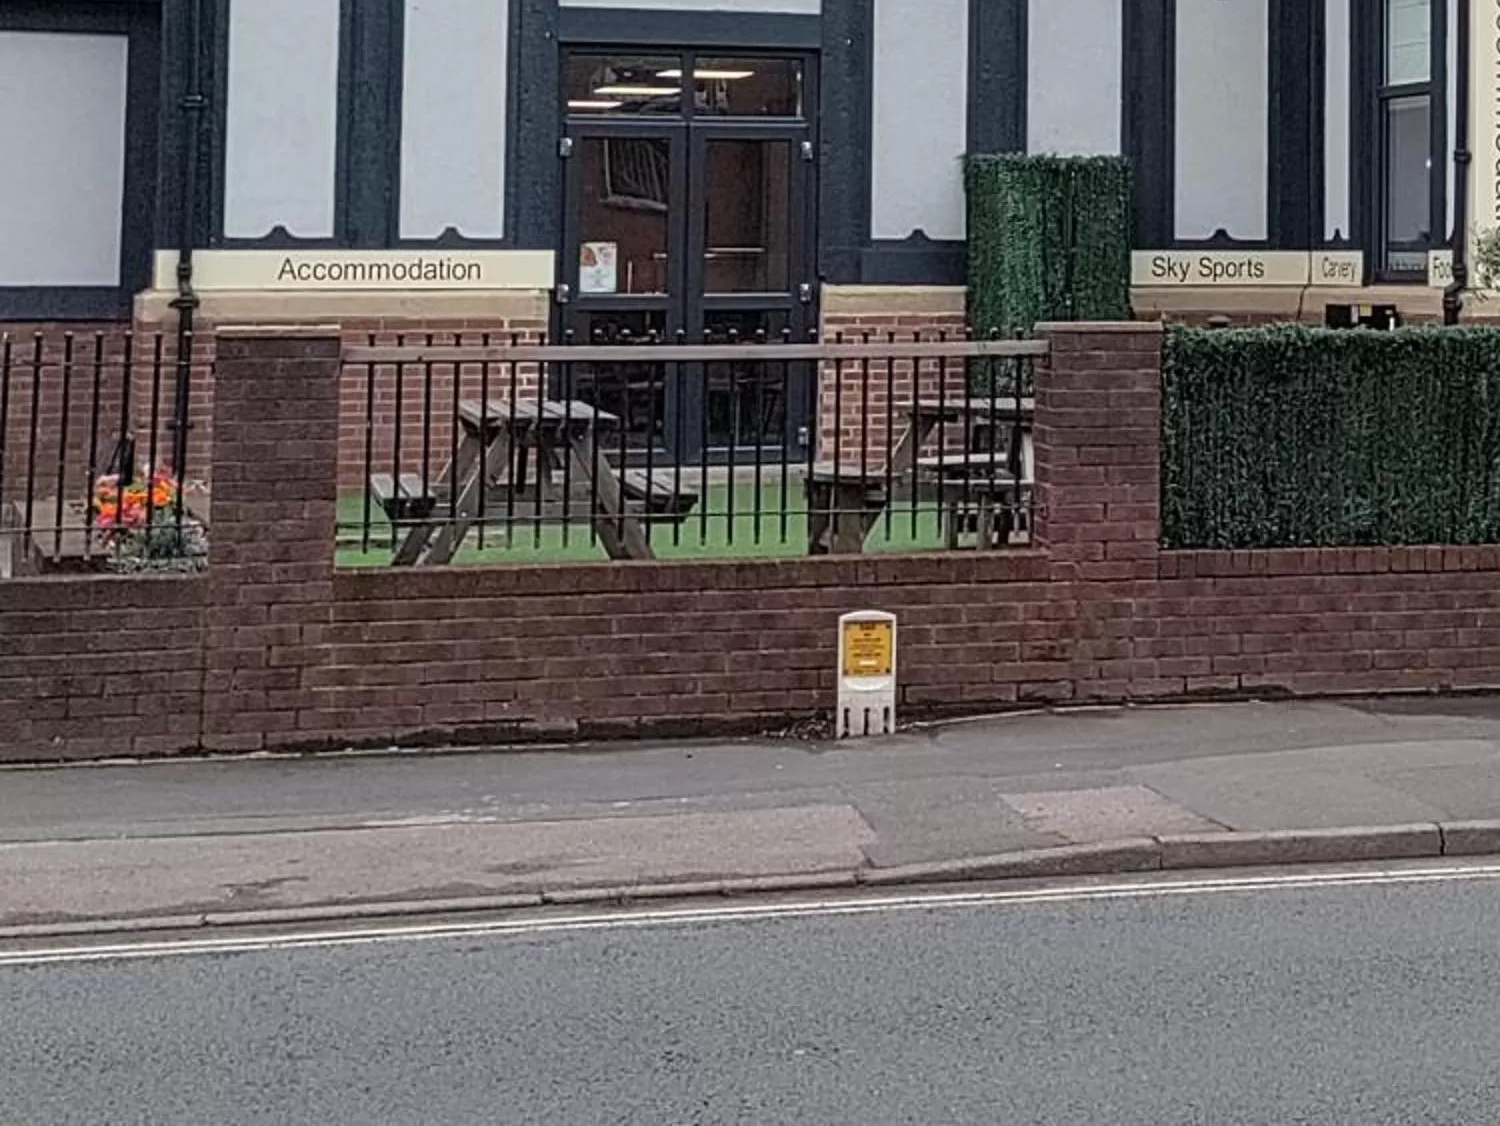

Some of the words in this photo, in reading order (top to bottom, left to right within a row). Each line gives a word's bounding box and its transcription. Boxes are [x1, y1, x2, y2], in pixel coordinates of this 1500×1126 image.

[277, 257, 482, 281] Accommodation
[1151, 257, 1191, 282] Sky
[1199, 258, 1265, 281] Sports
